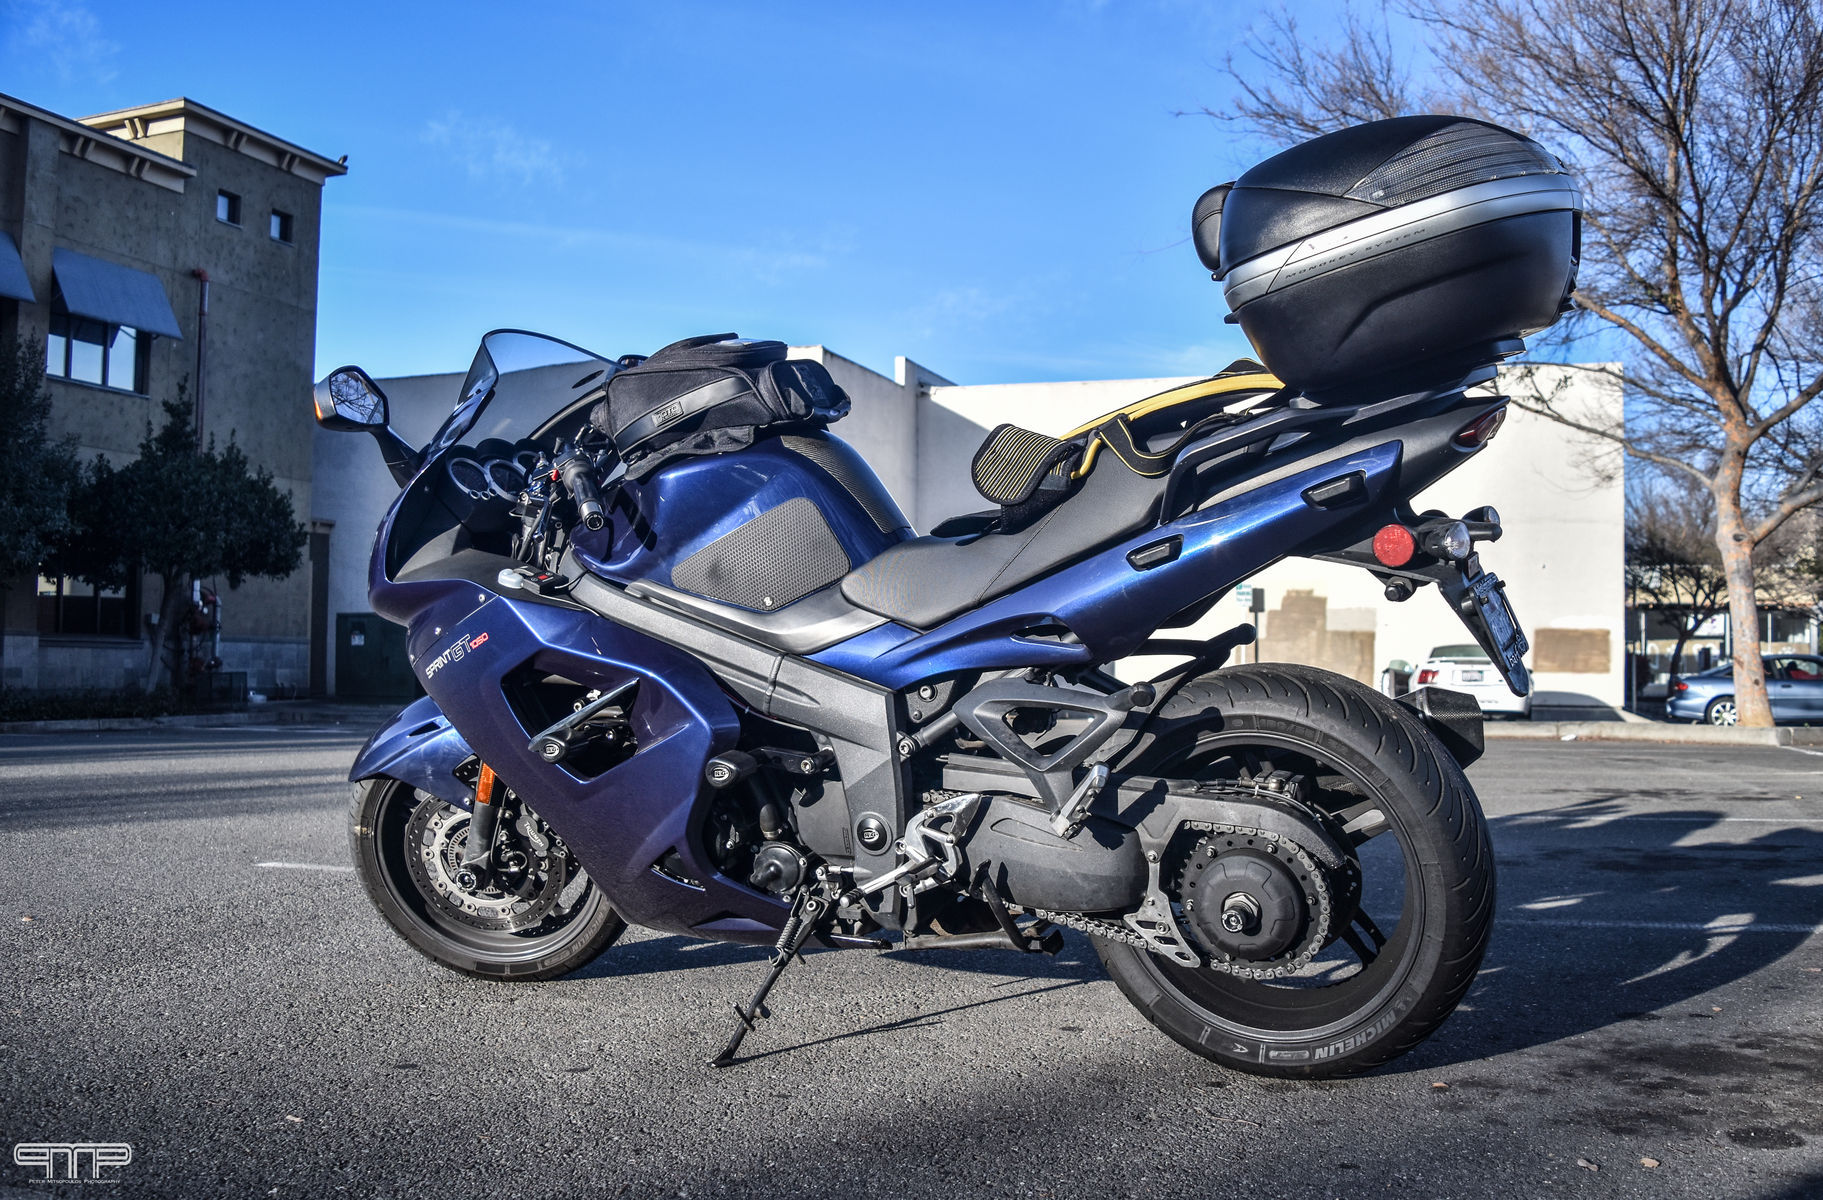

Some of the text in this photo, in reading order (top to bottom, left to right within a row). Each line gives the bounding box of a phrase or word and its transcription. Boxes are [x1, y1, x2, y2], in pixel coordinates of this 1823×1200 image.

[425, 649, 452, 679] SPRINT
[450, 633, 471, 662] GT
[524, 821, 544, 848] TRIUMPH
[1314, 1009, 1396, 1060] MICHELIN
